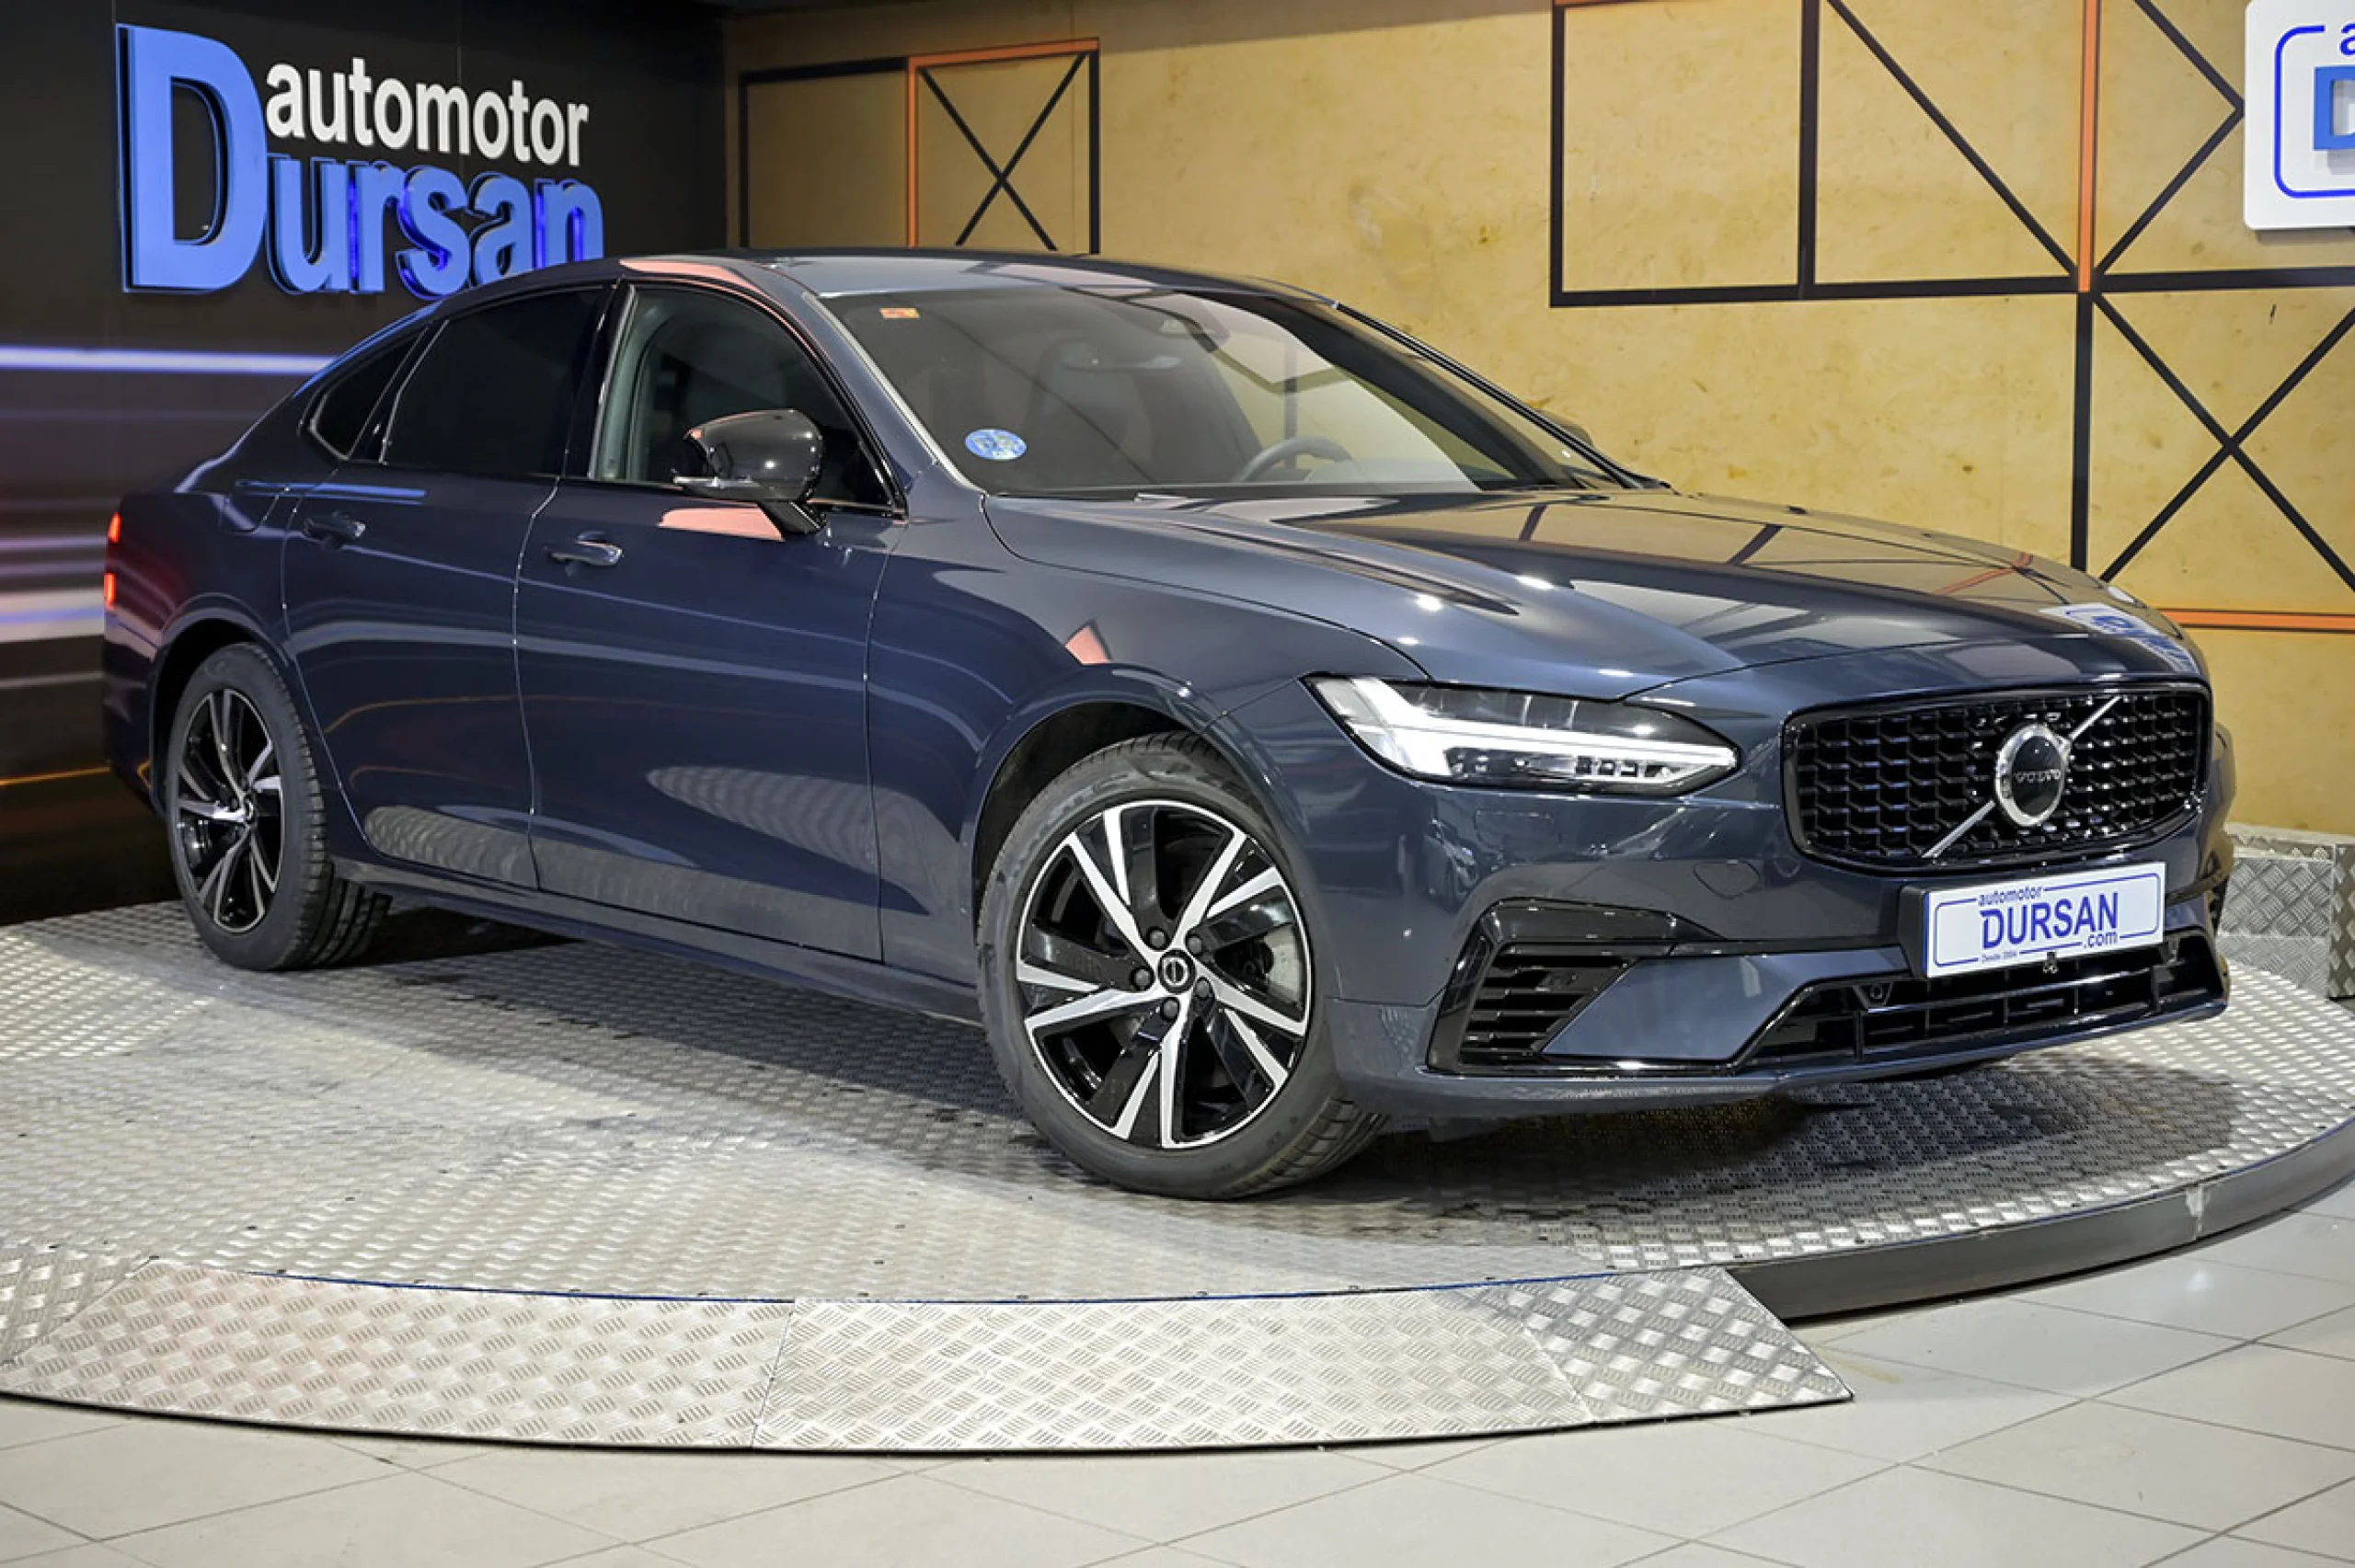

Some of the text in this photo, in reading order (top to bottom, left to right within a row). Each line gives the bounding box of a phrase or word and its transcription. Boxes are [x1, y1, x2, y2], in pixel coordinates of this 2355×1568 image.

[266, 57, 590, 166] automotor
[116, 23, 603, 300] Dursan
[1978, 886, 2042, 907] automotor
[1980, 892, 2119, 950] DURSAN
[2084, 932, 2119, 949] .com
